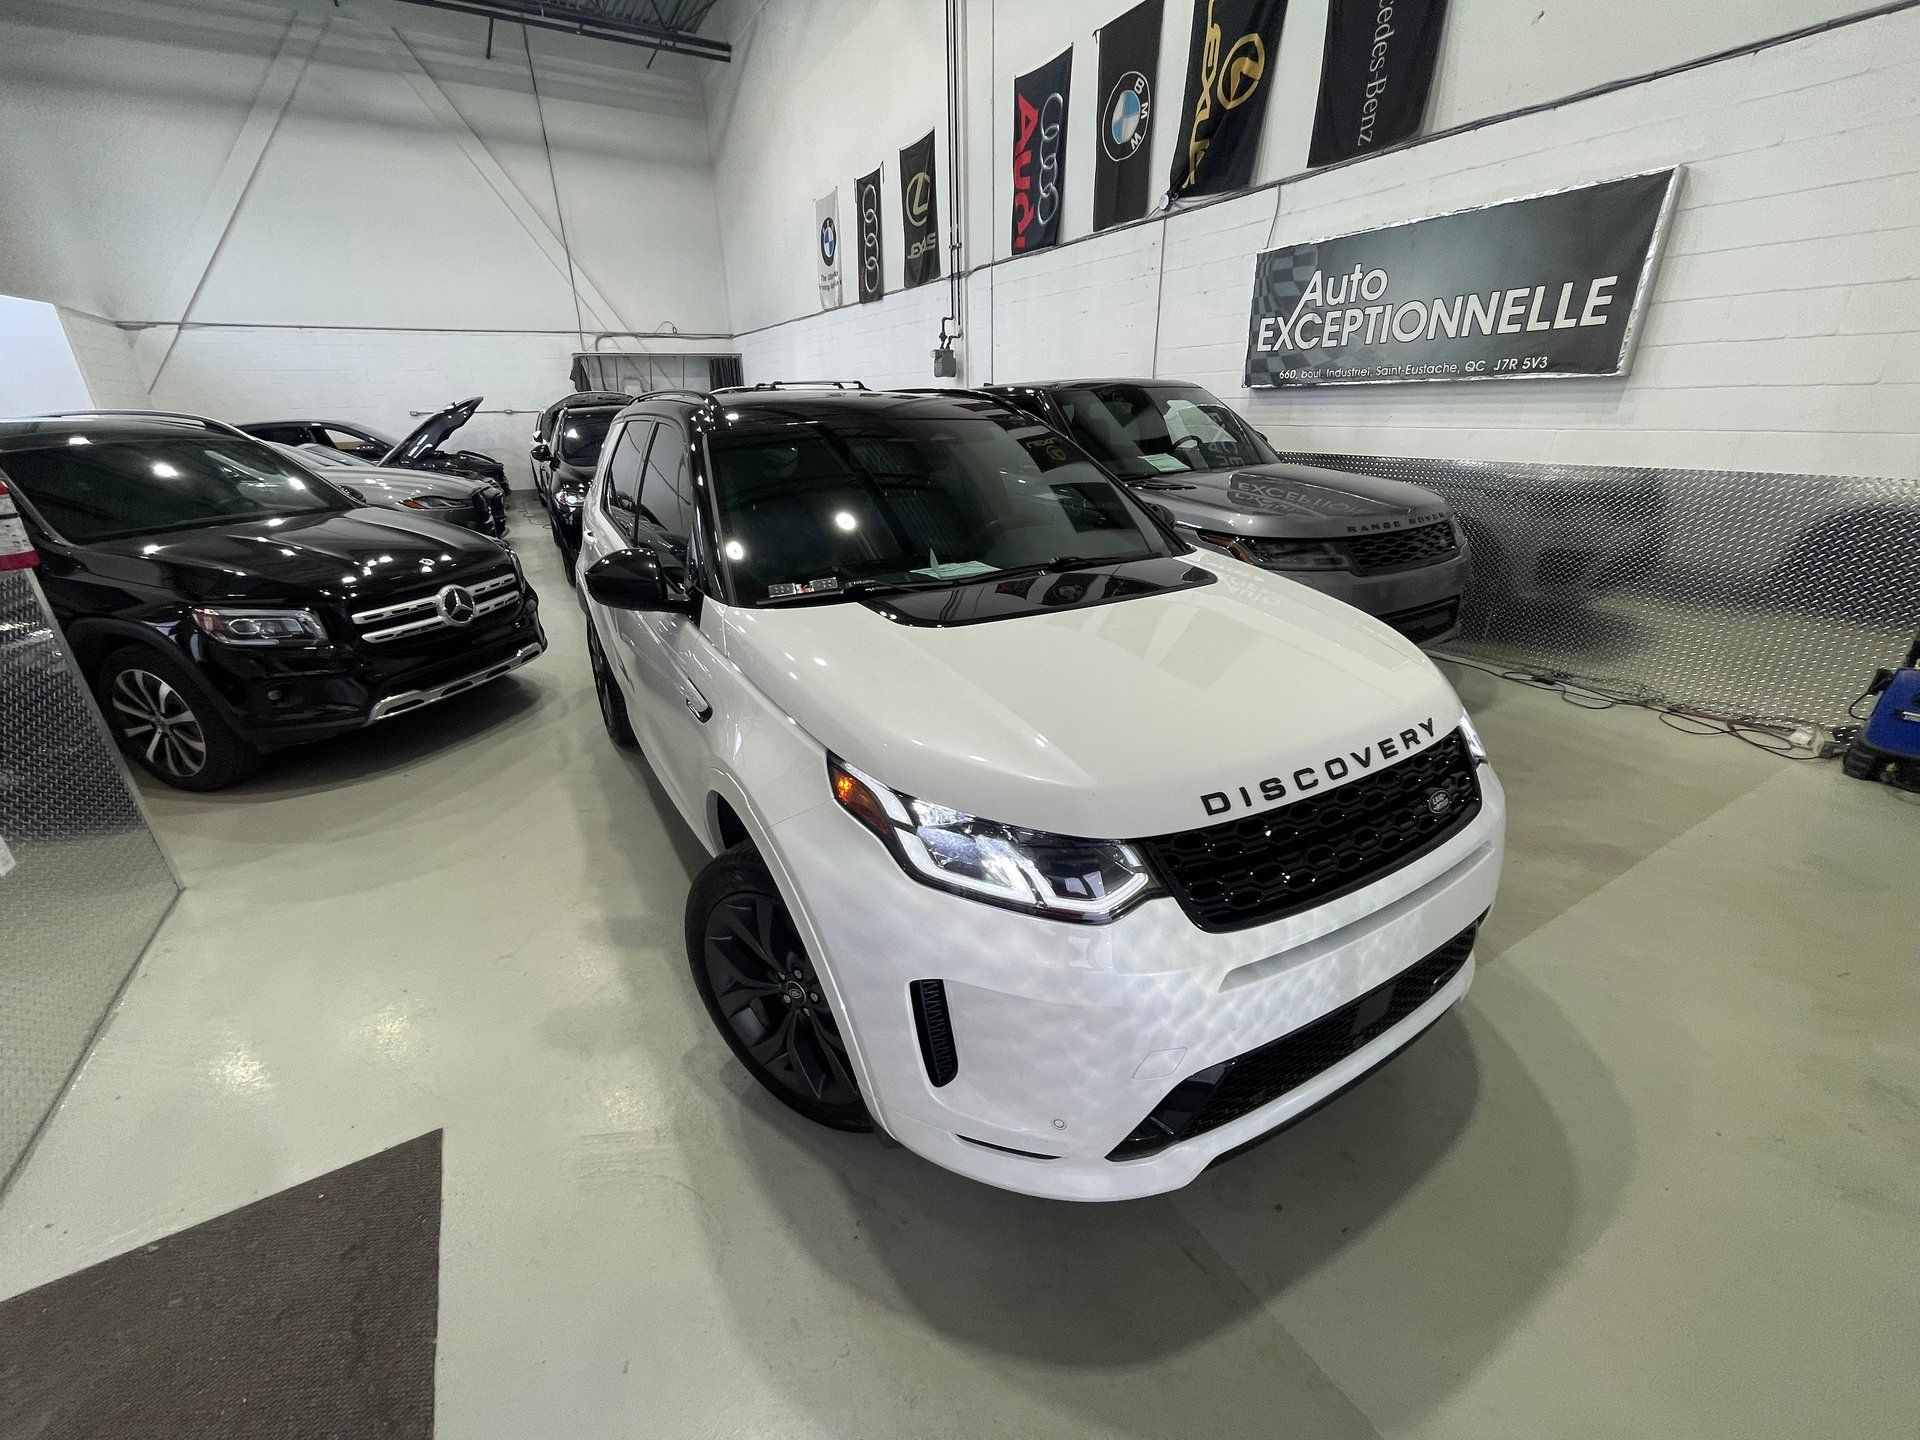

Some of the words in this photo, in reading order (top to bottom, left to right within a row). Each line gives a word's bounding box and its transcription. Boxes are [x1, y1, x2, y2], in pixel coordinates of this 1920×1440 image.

[1130, 76, 1149, 151] BMW
[1256, 275, 1619, 352] EXCEPTIONNELLE
[1302, 263, 1389, 307] Auto
[1375, 362, 1460, 377] Saint-Eustache,
[1465, 360, 1487, 372] QC
[1493, 358, 1519, 371] J7R
[1522, 356, 1548, 370] 5V3
[1346, 520, 1401, 533] RANGE
[1408, 512, 1445, 525] ROVER
[1200, 717, 1435, 816] DISCOVERY
